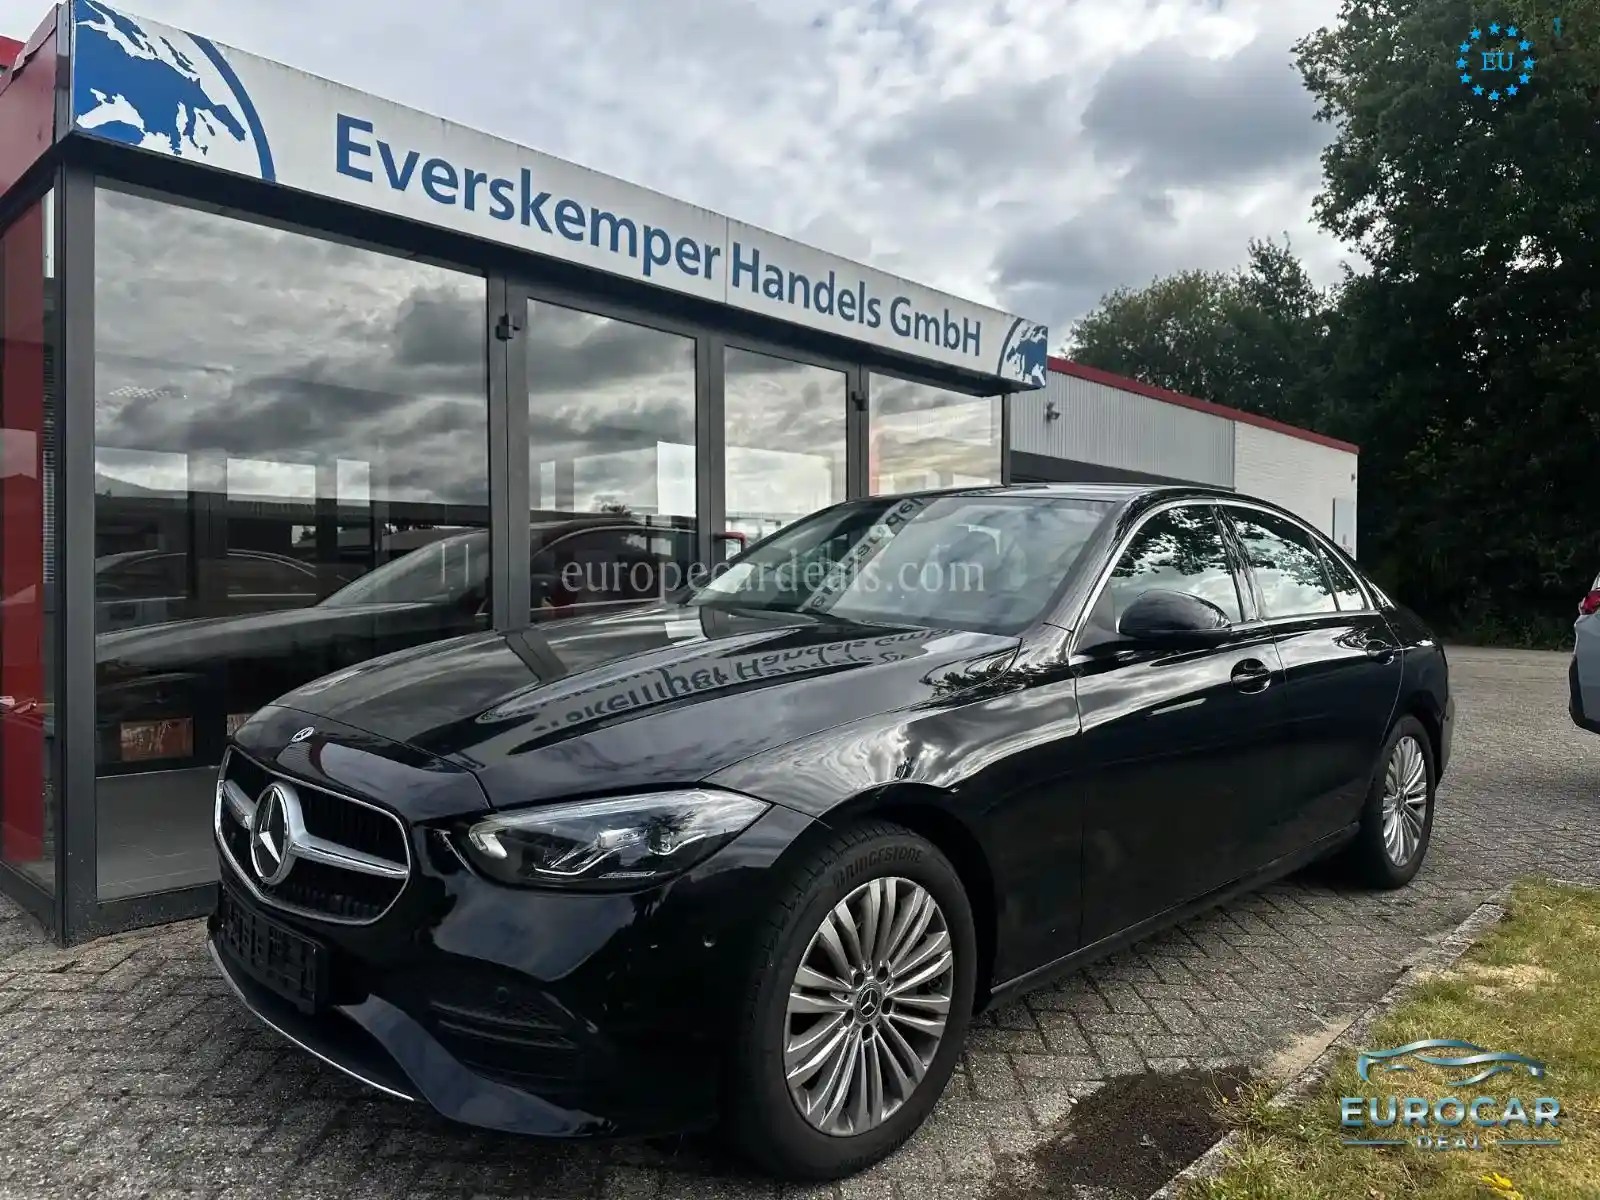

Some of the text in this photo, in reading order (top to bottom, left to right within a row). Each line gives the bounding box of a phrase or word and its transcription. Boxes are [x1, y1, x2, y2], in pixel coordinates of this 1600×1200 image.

[336, 113, 981, 356] Everskemper Handels GmbH
